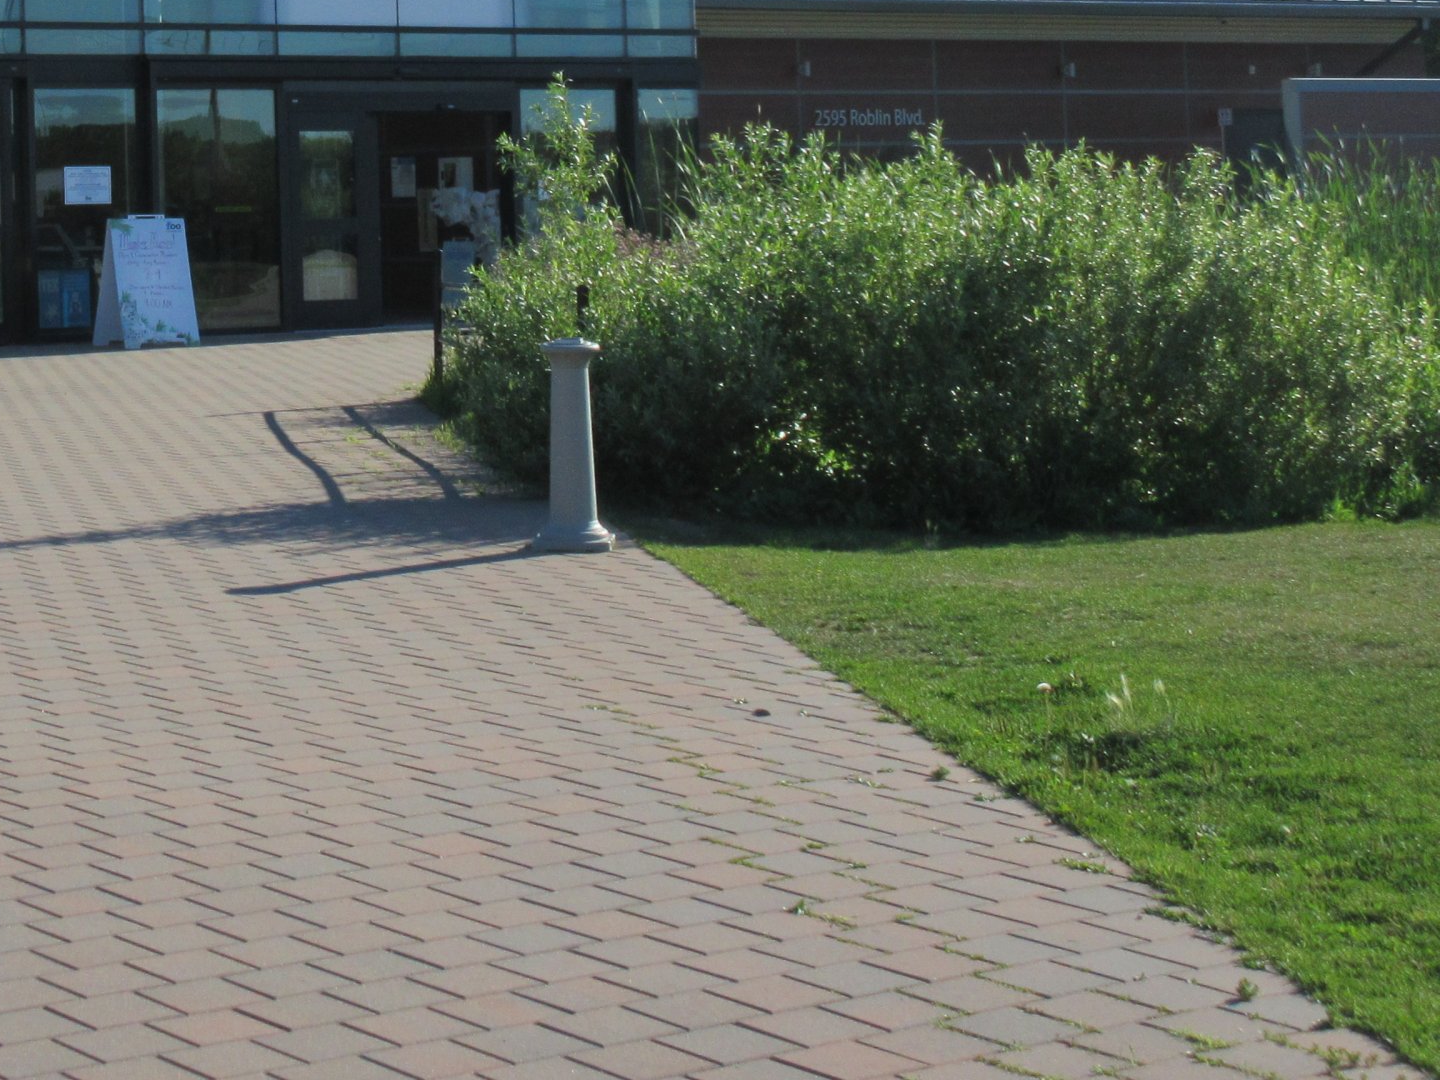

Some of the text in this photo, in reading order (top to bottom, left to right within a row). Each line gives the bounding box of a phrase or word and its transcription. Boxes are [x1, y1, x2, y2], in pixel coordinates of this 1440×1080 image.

[815, 108, 926, 126] 2595 Roblin Blvd.
